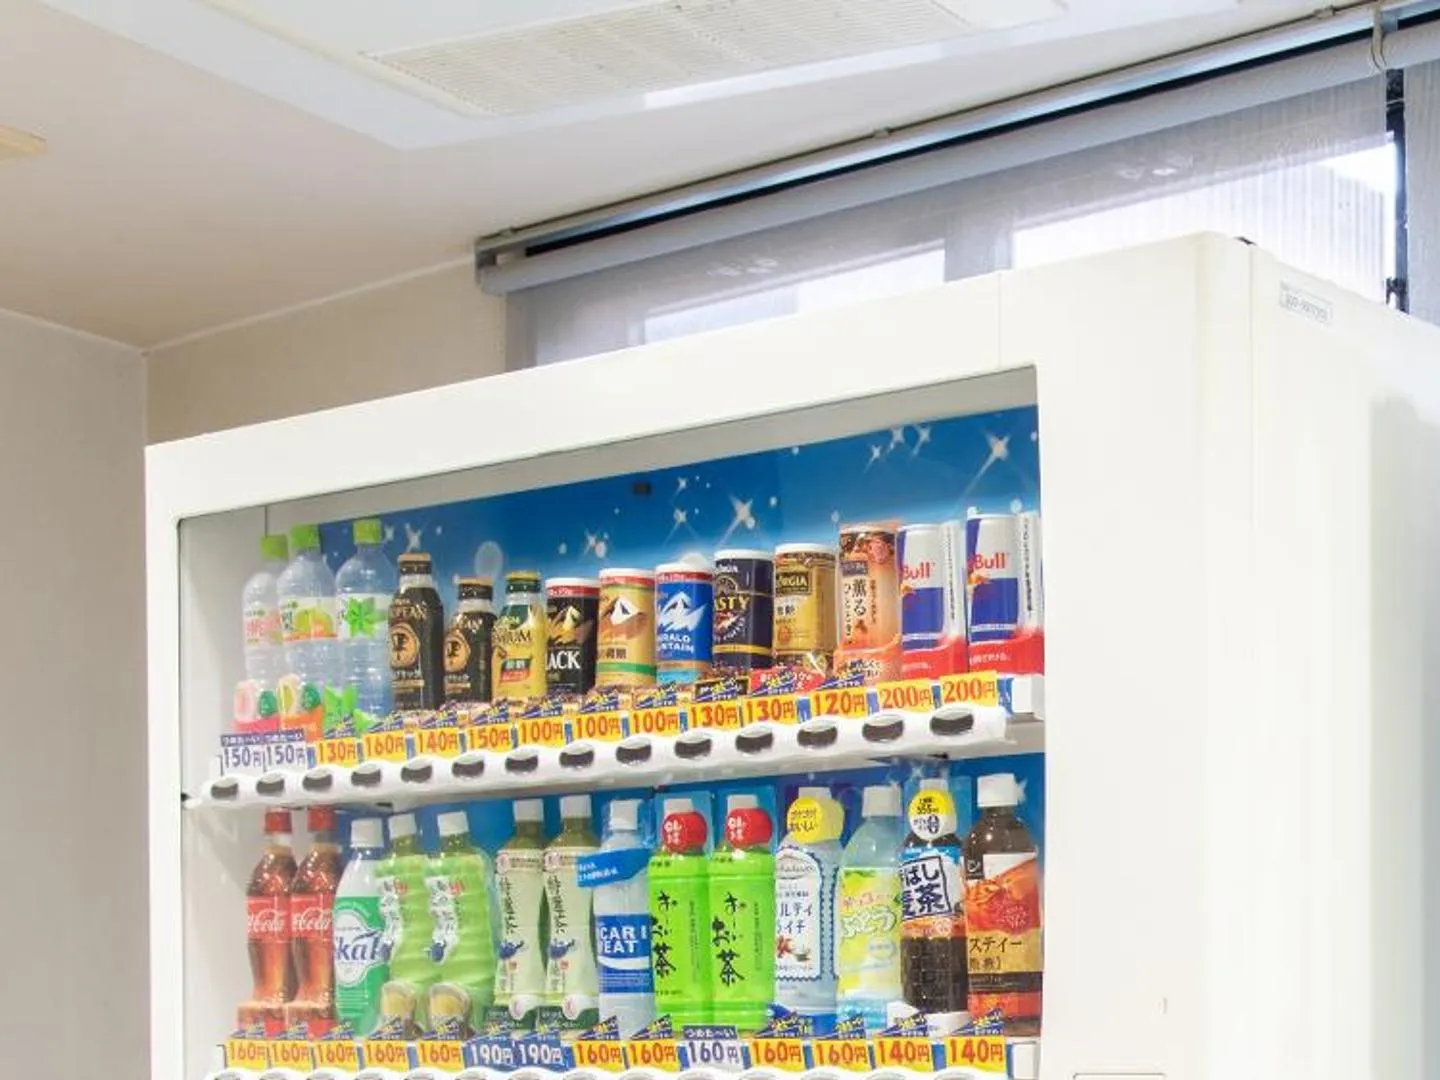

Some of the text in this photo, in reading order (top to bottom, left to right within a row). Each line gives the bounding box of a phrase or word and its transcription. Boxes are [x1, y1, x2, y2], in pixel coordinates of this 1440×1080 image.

[973, 552, 1007, 571] Bull
[547, 650, 582, 670] ACK
[880, 684, 932, 709] 200円
[943, 679, 996, 703] 200円
[747, 699, 795, 721] 130円
[814, 690, 867, 715] 120円
[632, 710, 679, 728] 100円
[690, 703, 738, 727] 130円
[469, 726, 510, 745] 150円
[521, 721, 563, 741] 100円
[576, 716, 621, 737] 100円
[366, 736, 405, 756] 160円
[418, 731, 458, 751] 140円
[223, 747, 263, 768] 150円
[266, 745, 306, 766] 150円
[318, 742, 357, 762] 130円
[907, 862, 940, 885] ばし
[599, 925, 648, 941] CARI
[969, 937, 1023, 953] スティー
[230, 1044, 266, 1062] 160円
[272, 1045, 310, 1063] 160円
[318, 1045, 356, 1063] 160円
[367, 1045, 405, 1063] 160円
[420, 1045, 460, 1063] 160円
[471, 1045, 513, 1063] 190円
[519, 1045, 563, 1064] 190円
[577, 1044, 622, 1064] 160円
[630, 1043, 675, 1064] 160円
[688, 1042, 741, 1064] 160円
[752, 1044, 803, 1064] 160円
[815, 1043, 867, 1064] 160円
[880, 1042, 931, 1064] 140円
[951, 1042, 1004, 1064] 140円
